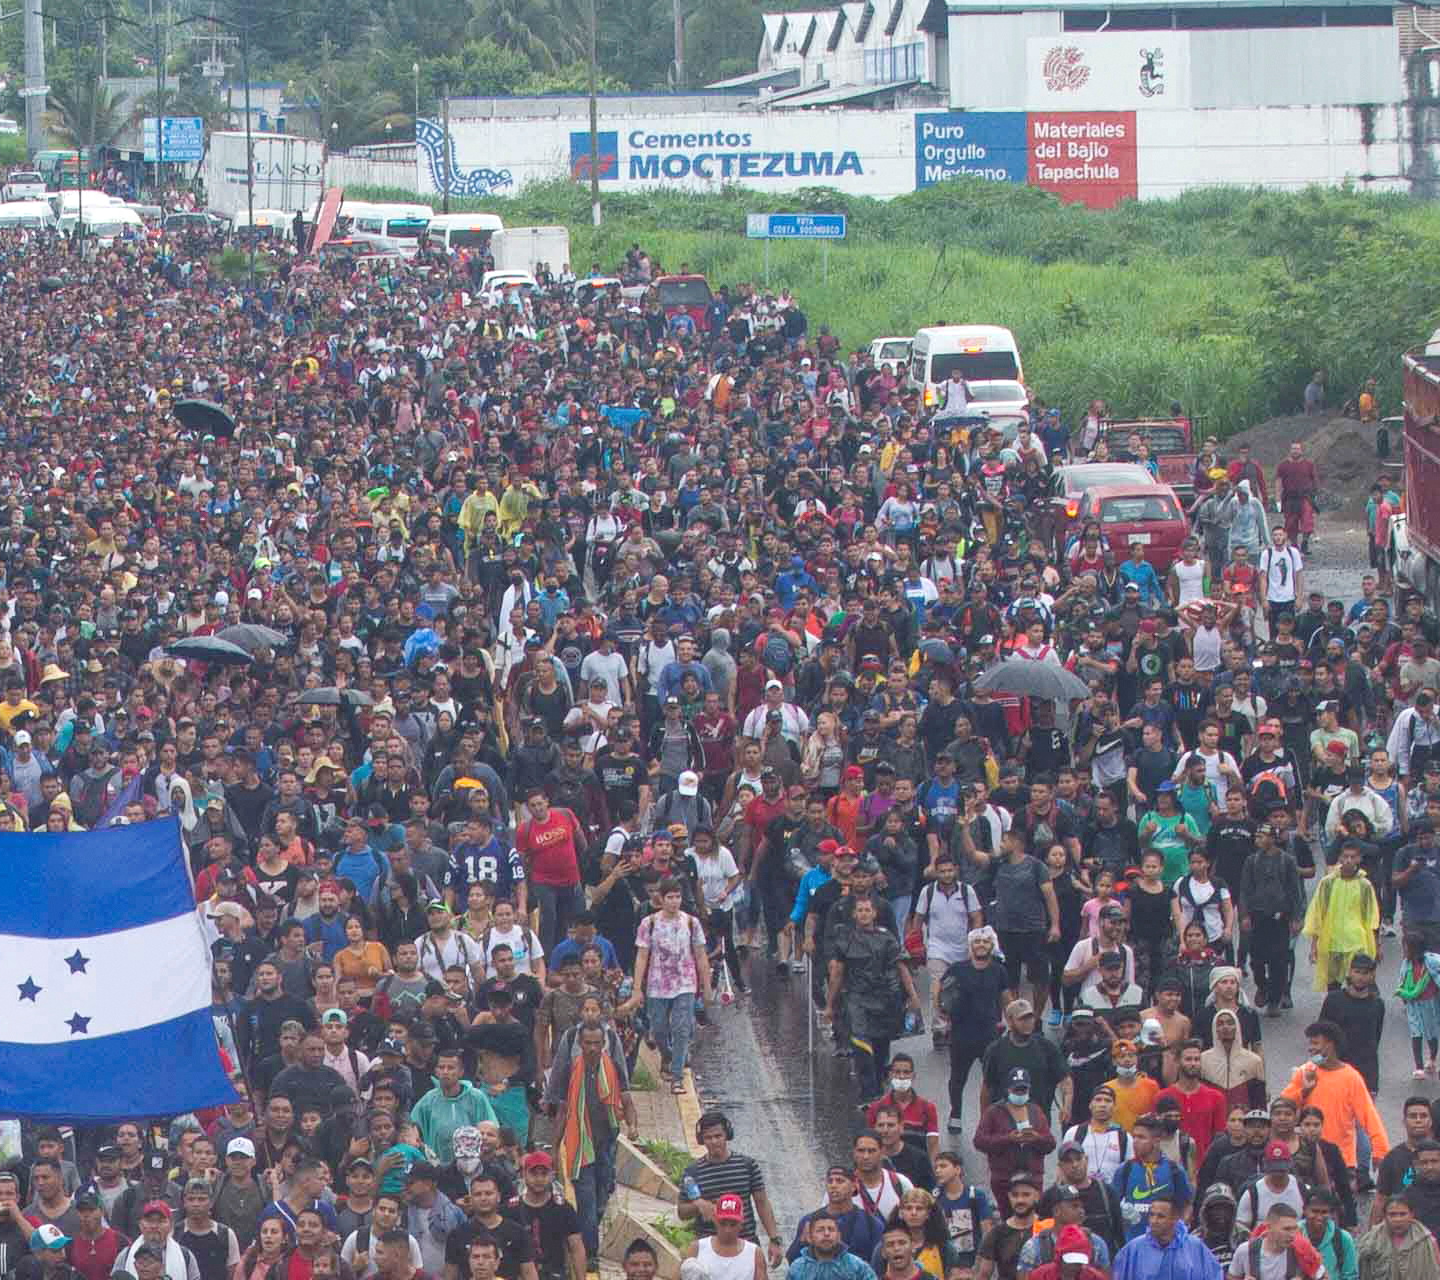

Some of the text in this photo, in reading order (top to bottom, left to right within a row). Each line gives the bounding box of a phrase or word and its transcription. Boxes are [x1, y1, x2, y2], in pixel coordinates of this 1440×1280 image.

[628, 130, 752, 149] Cementos
[923, 122, 963, 140] Puro
[1034, 121, 1125, 139] Materiales
[924, 144, 985, 165] Orgullo
[1035, 143, 1054, 158] del
[629, 152, 863, 180] MOCTEZUMA
[1035, 162, 1120, 182] Tapachula
[465, 856, 498, 883] 18
[721, 1199, 737, 1210] CAT
